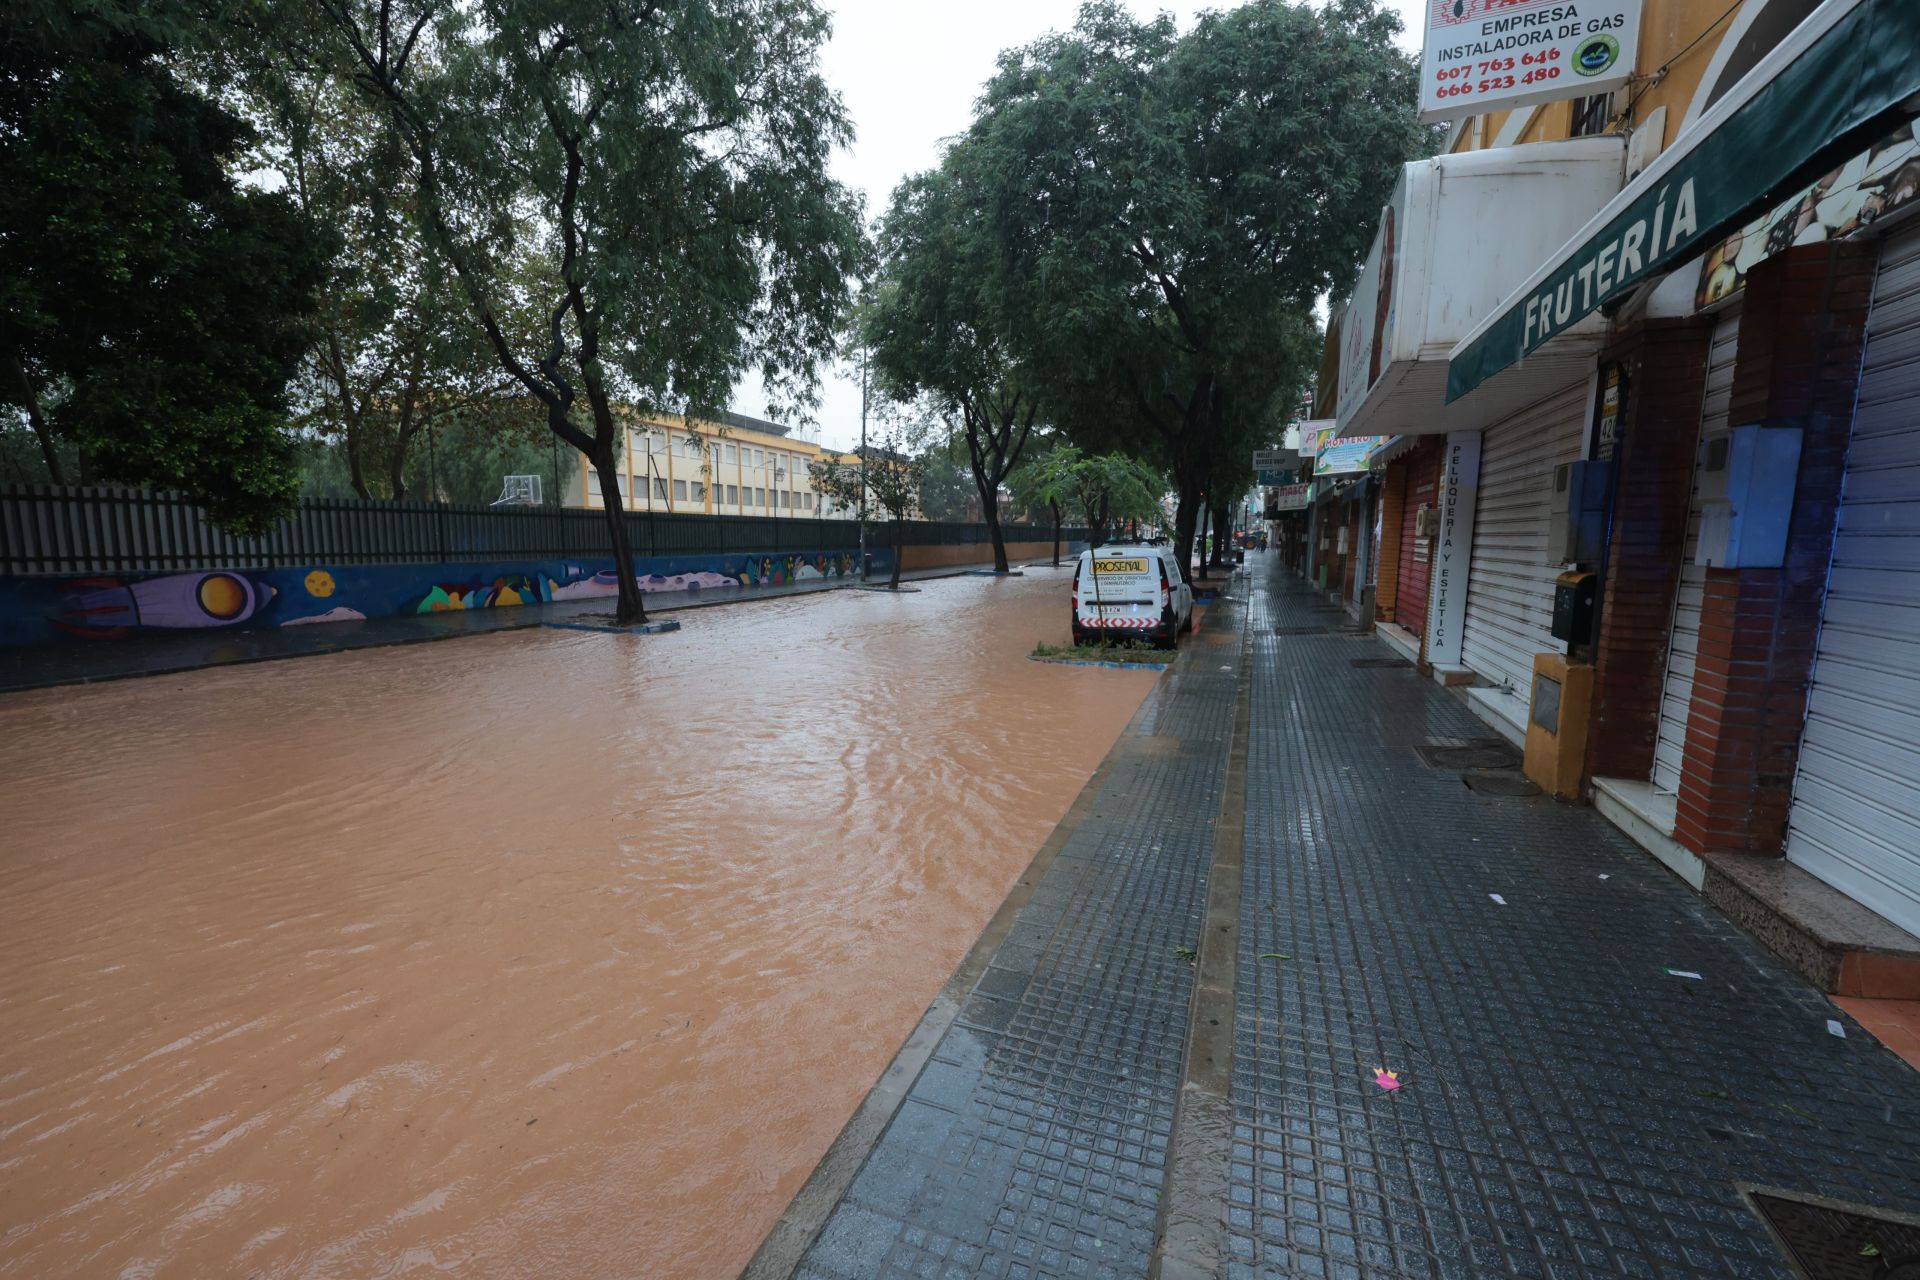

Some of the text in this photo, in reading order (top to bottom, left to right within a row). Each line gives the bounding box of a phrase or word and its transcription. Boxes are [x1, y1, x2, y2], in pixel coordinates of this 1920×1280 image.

[1482, 5, 1577, 36] EMPRESA
[1438, 29, 1553, 62] INSTALADORA
[1558, 22, 1582, 39] DE
[1587, 13, 1625, 33] GAS
[1436, 48, 1560, 81] 607 763 646
[1436, 67, 1560, 98] 666 523 480
[1523, 177, 1697, 349] FRUTERÍA
[1443, 554, 1451, 562] Y
